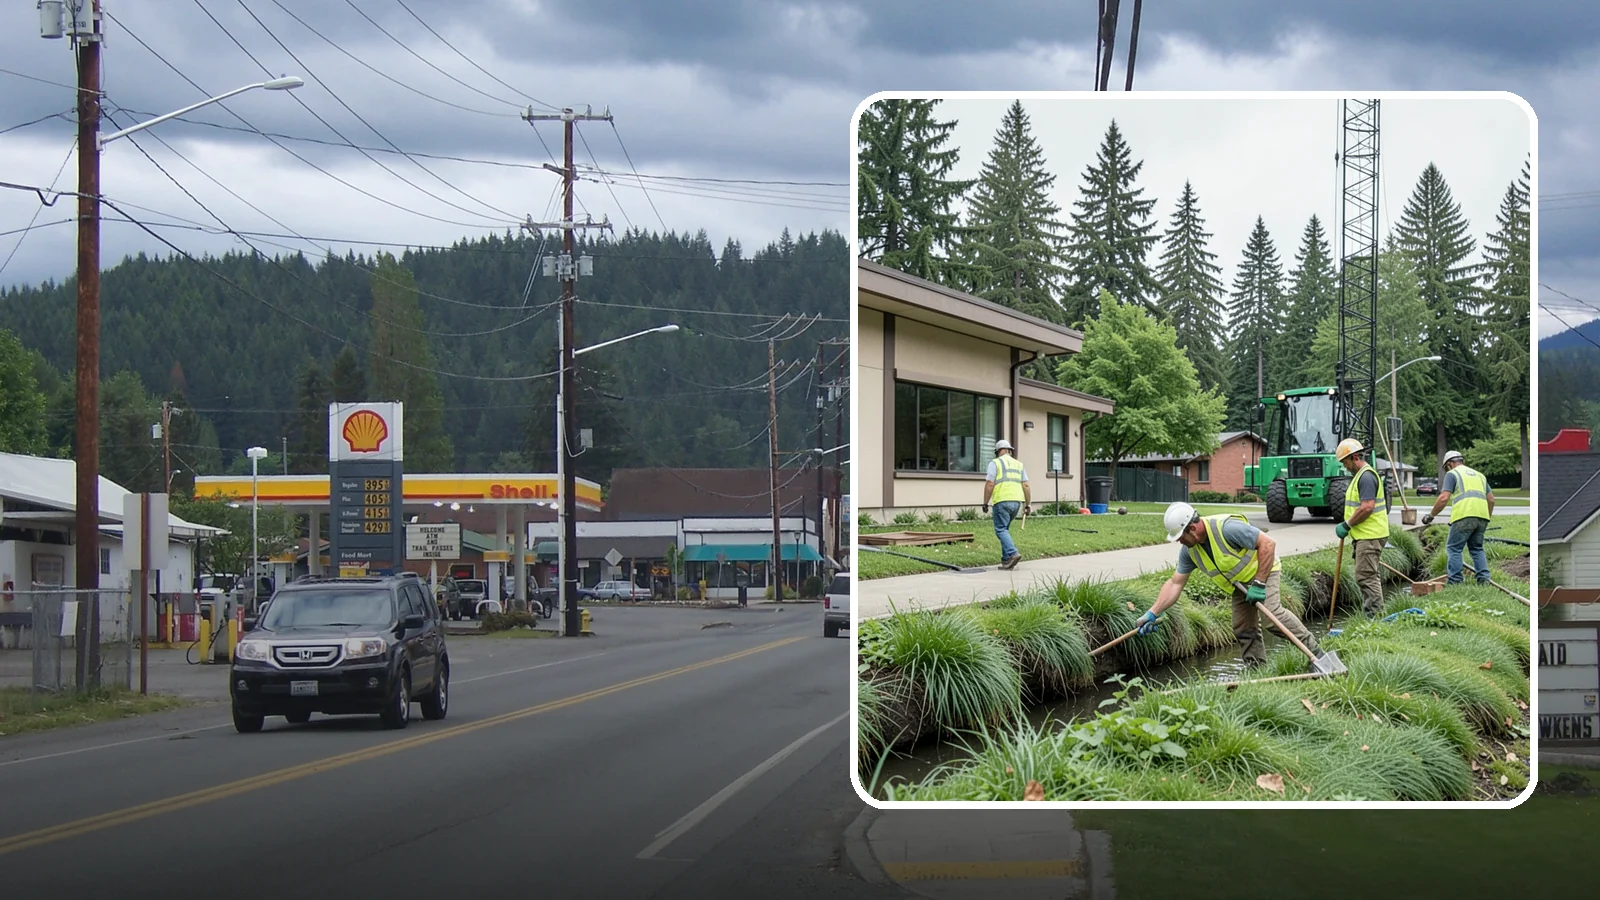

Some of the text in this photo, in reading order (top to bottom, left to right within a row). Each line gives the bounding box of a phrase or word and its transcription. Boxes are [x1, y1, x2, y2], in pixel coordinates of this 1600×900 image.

[366, 480, 384, 490] 395
[490, 484, 547, 499] Shell
[366, 494, 384, 504] 405
[366, 508, 384, 518] 415
[366, 522, 384, 532] 429
[1538, 643, 1567, 665] AID
[1538, 716, 1592, 739] WKENS
